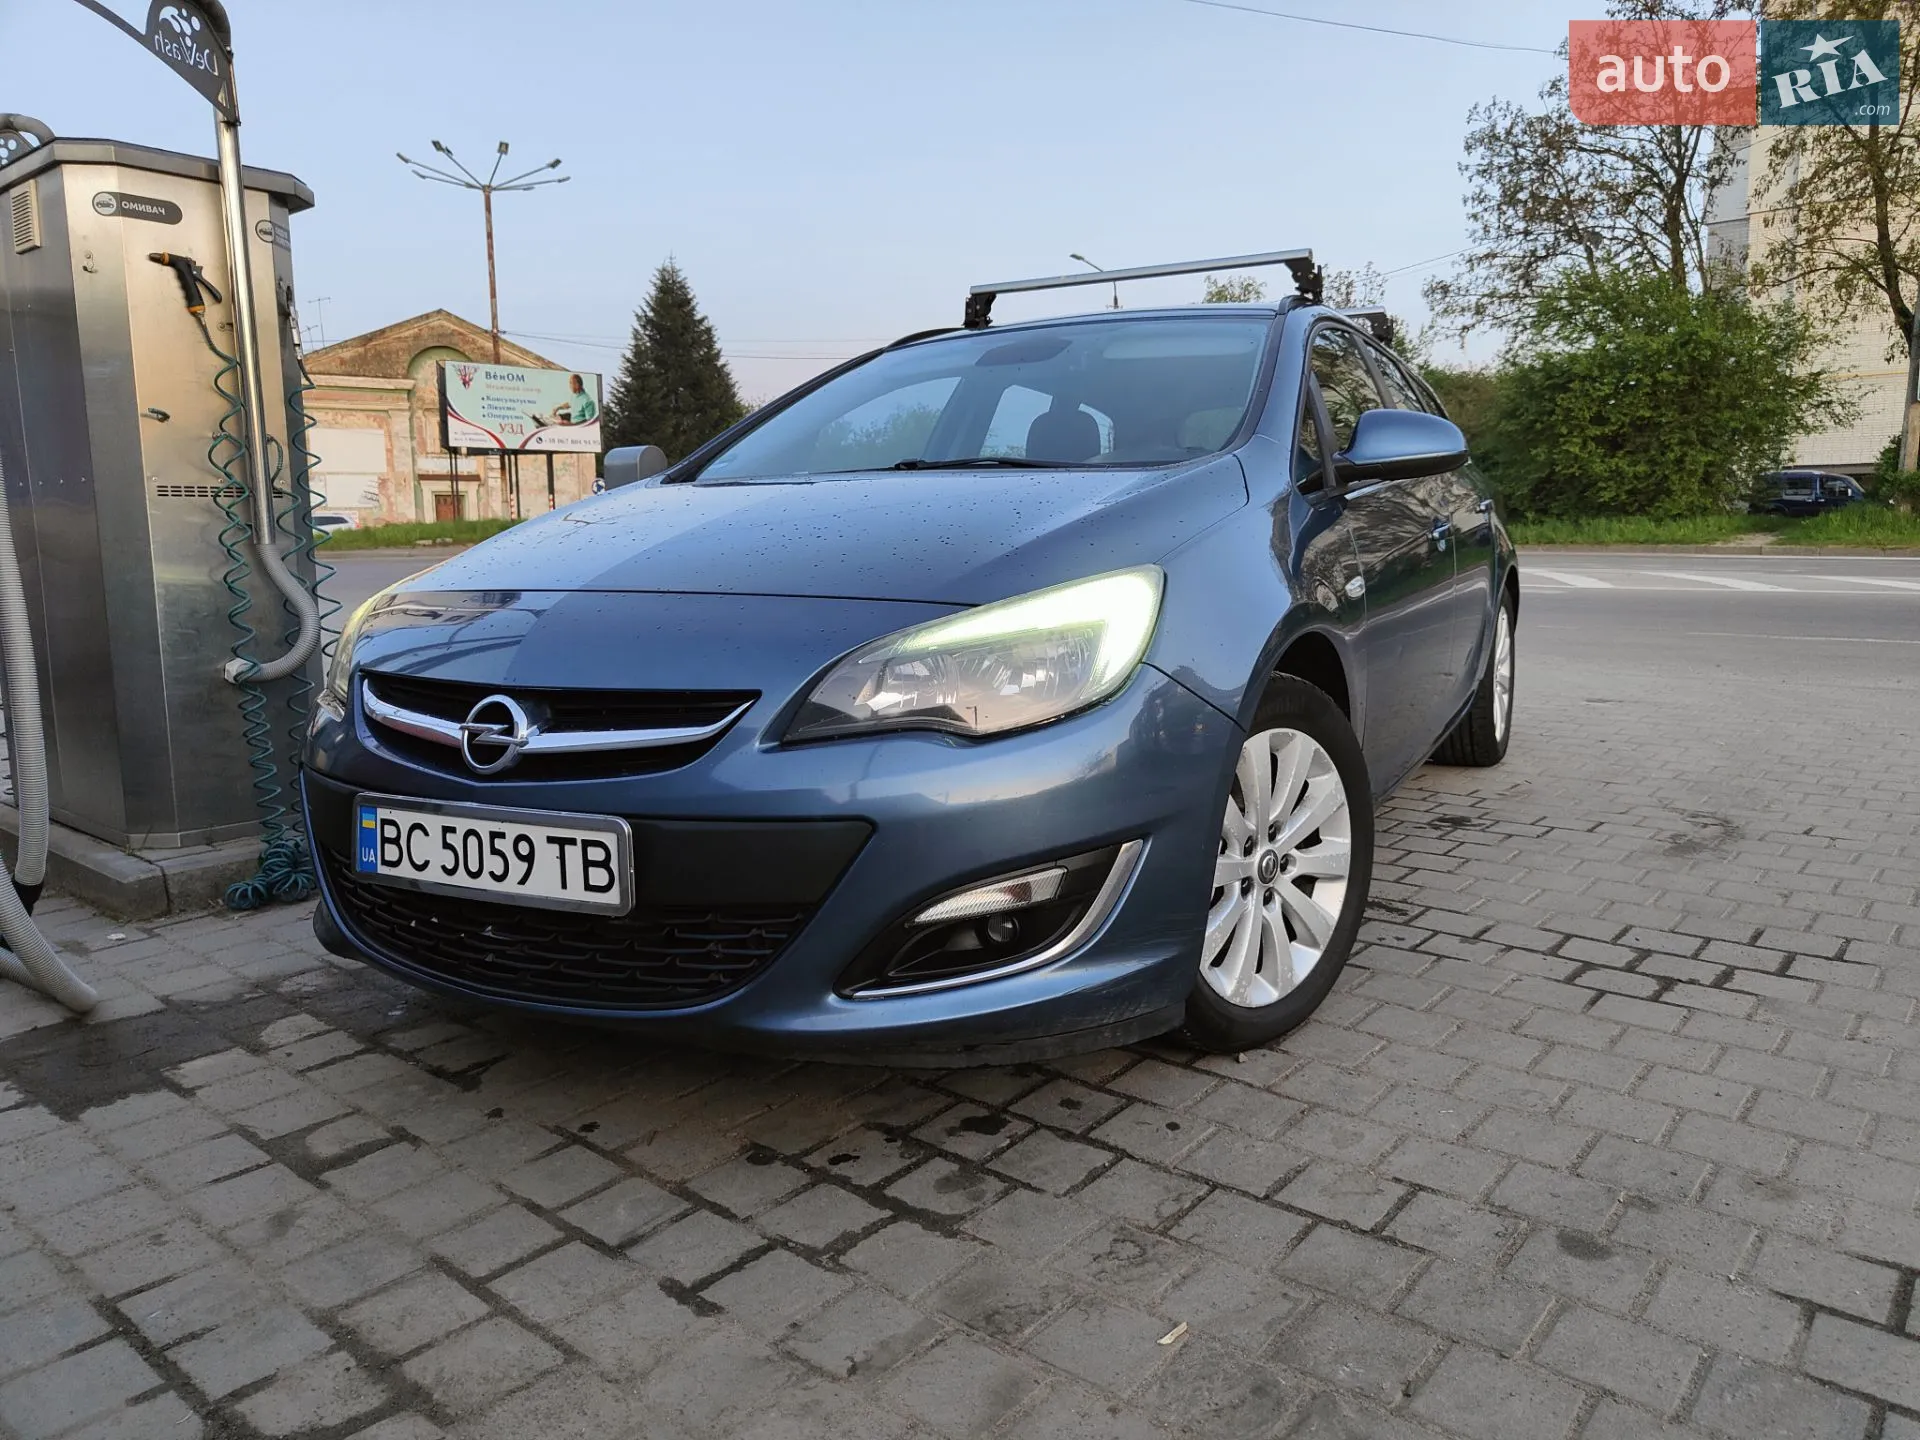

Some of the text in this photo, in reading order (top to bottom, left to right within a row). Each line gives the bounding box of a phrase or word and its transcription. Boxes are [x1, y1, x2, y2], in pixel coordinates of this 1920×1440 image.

[121, 201, 166, 216] ОМИВАЧ
[499, 423, 525, 436] УЗД
[361, 848, 376, 863] UA
[379, 817, 616, 894] BC 5059 TB
